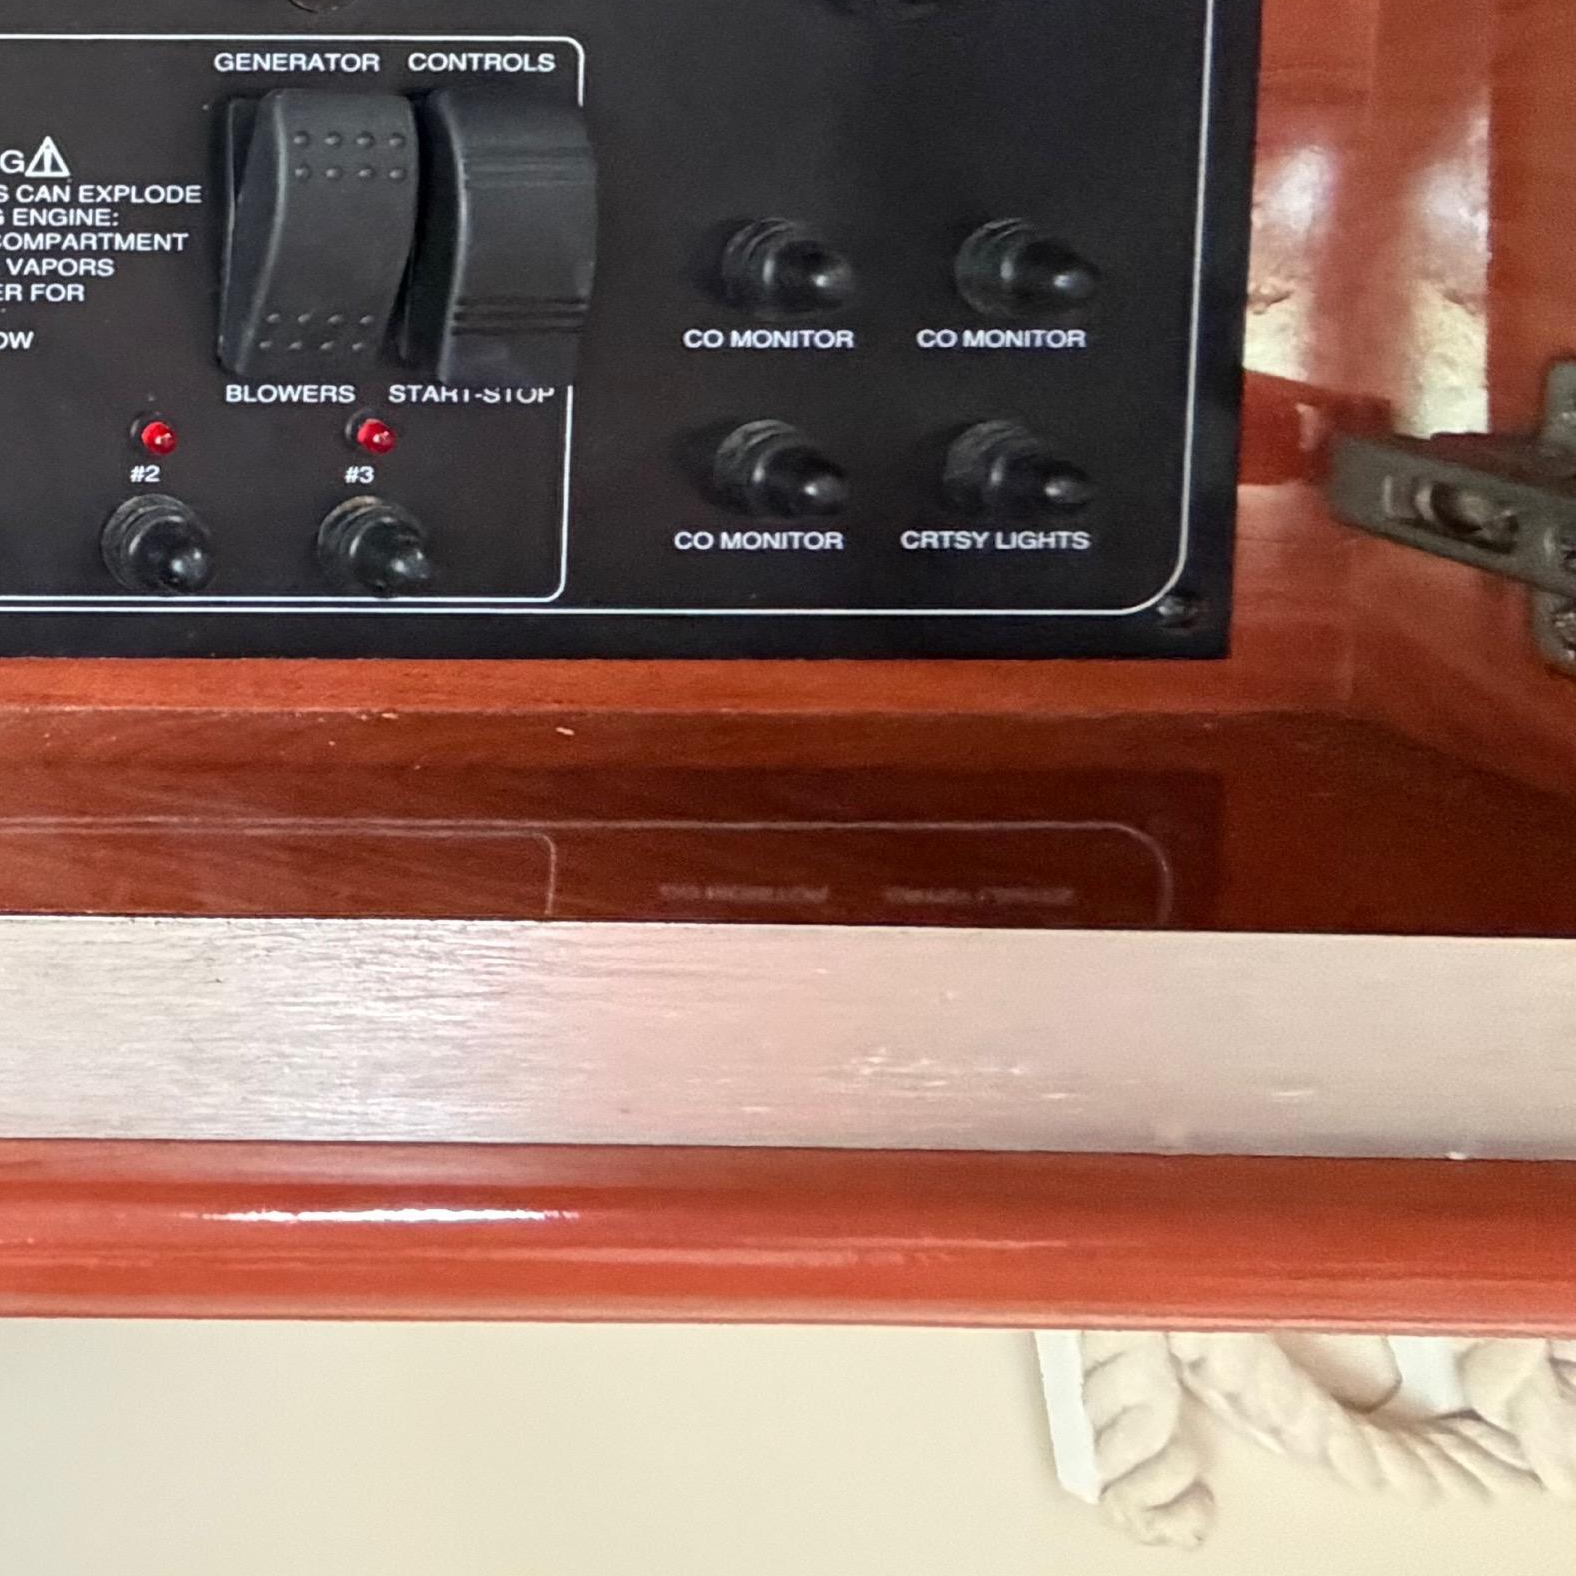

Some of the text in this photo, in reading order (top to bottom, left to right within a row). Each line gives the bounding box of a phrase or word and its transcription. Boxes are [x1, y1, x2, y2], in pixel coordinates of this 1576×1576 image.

[213, 52, 557, 72] GENERATOR CONTROLS
[15, 184, 71, 203] CAN
[77, 184, 202, 204] EXPLODE
[12, 207, 119, 227] ENGINE:
[5, 257, 115, 277] VAPORS
[29, 282, 85, 302] FOR
[682, 328, 855, 348] CO MONITOR
[915, 328, 1087, 348] CO MONITOR
[225, 384, 356, 403] BLOWERS
[129, 464, 161, 482] #2
[343, 465, 375, 484] #3
[673, 530, 844, 550] CO MONITOR
[899, 530, 1091, 550] CRTSY LIGHTS
